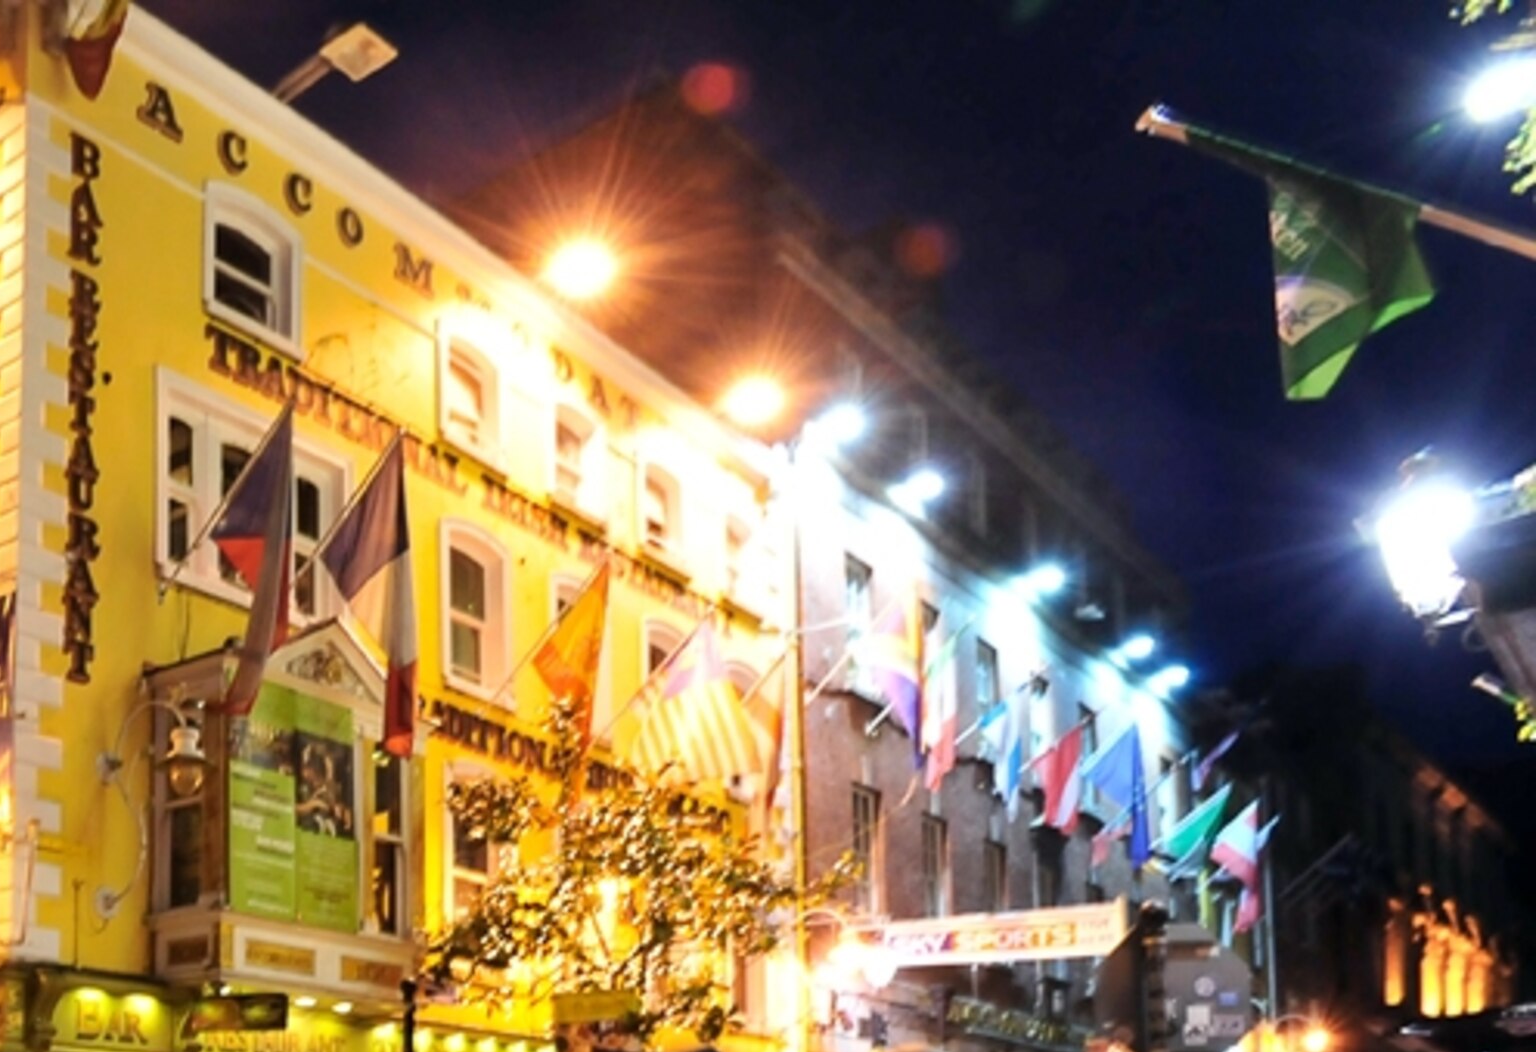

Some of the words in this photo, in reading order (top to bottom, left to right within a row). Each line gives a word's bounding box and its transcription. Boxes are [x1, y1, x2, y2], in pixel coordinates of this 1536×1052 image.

[68, 130, 104, 267] BAR
[60, 268, 104, 686] RESTAURANT
[958, 920, 1076, 953] SPORTS
[75, 1000, 149, 1045] BAR
